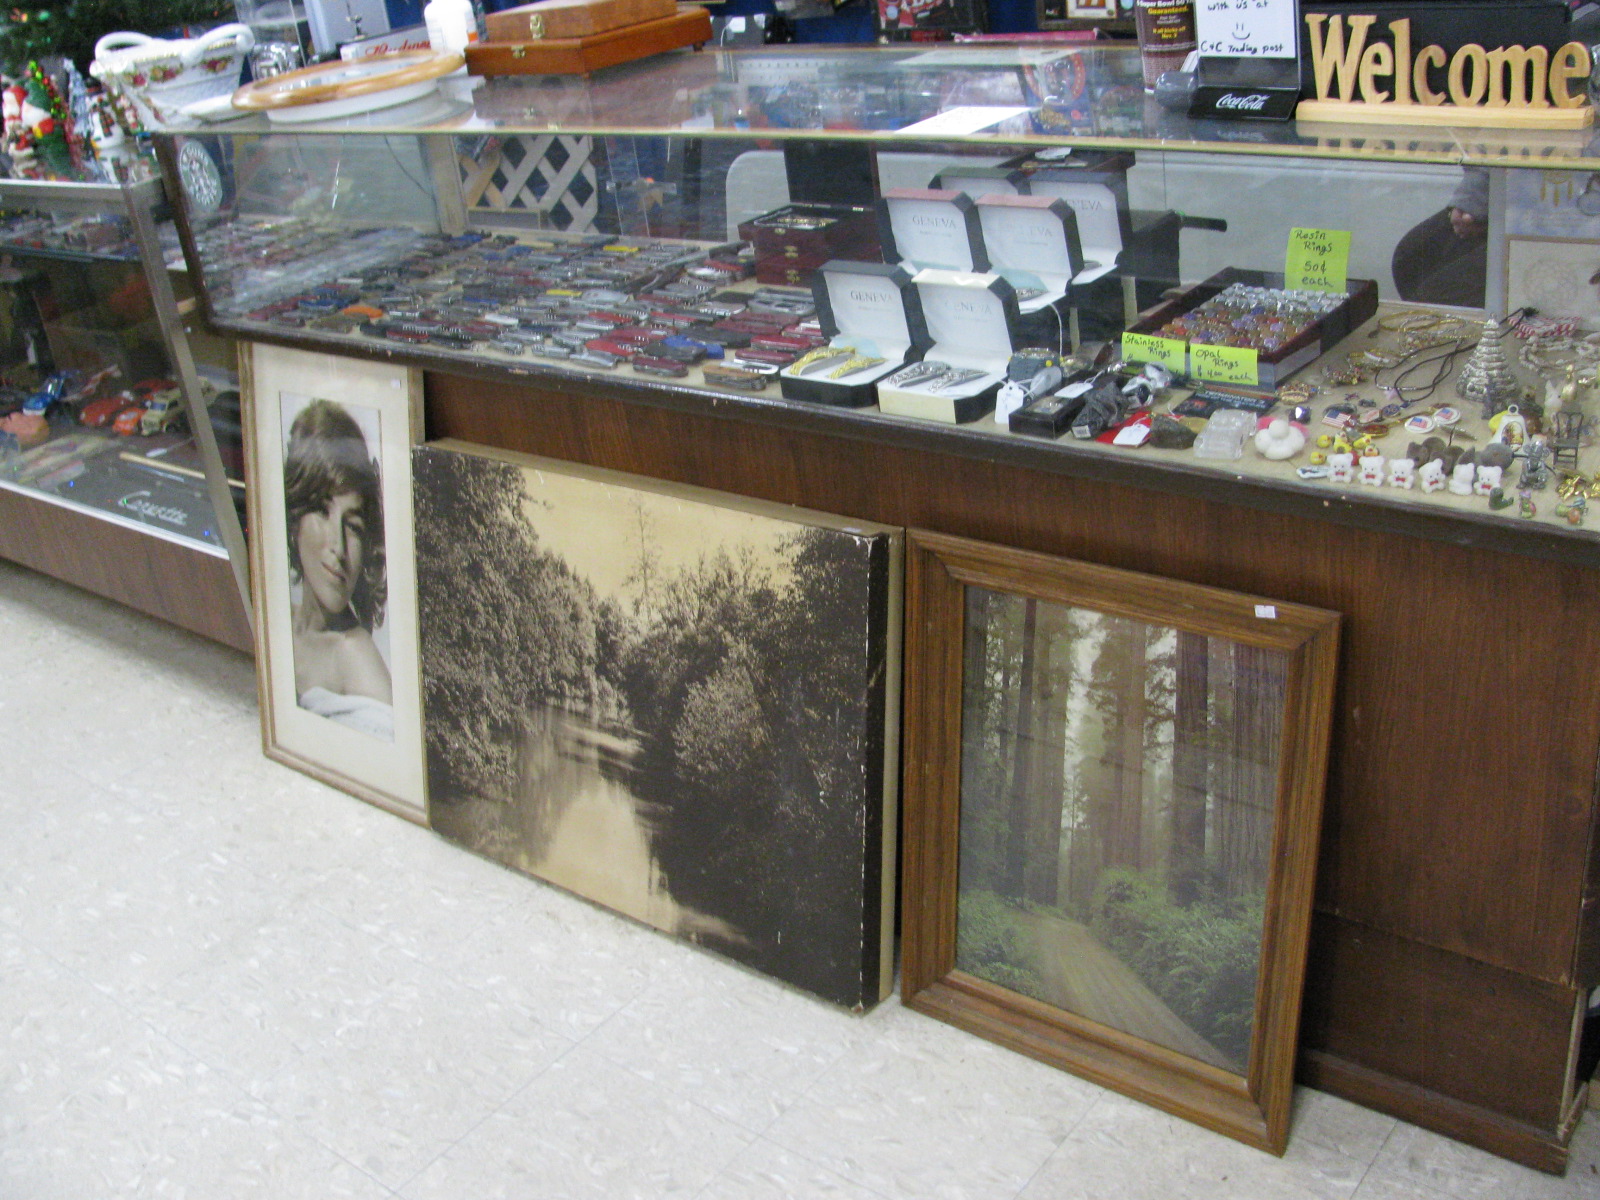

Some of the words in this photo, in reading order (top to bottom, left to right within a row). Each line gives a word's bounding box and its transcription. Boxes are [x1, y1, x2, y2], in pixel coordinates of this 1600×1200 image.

[1207, 2, 1229, 11] with
[1236, 1, 1248, 9] us
[1256, 0, 1268, 8] at
[1228, 43, 1258, 55] Trading
[1262, 43, 1284, 54] post
[1304, 13, 1591, 109] Welcome
[912, 214, 957, 230] GENEVA
[1294, 229, 1326, 240] Resin
[1303, 240, 1333, 256] Rings
[1301, 276, 1334, 288] each
[850, 289, 893, 304] GENEVA
[1124, 333, 1164, 349] Stainless
[1148, 345, 1171, 360] Rings
[1195, 348, 1221, 361] Opal
[1212, 358, 1239, 370] Rings
[1228, 372, 1253, 381] each
